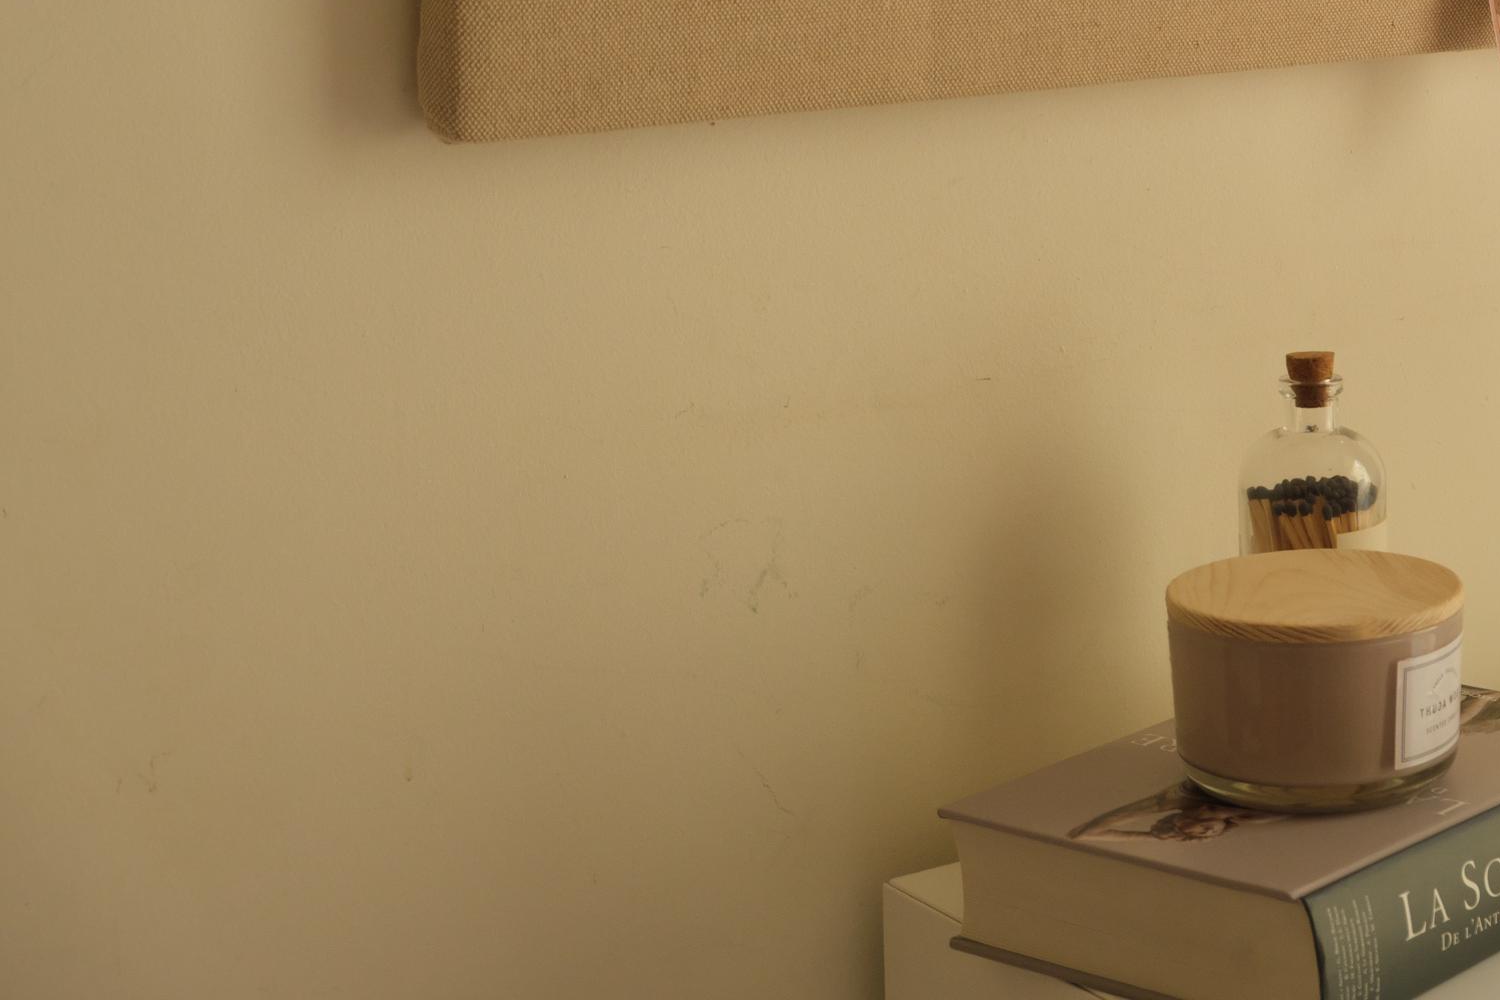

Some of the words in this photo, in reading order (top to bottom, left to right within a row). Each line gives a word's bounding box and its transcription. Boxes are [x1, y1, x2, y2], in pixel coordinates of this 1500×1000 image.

[1419, 697, 1447, 720] THUJA
[1398, 889, 1451, 942] LA
[1440, 931, 1461, 952] DE
